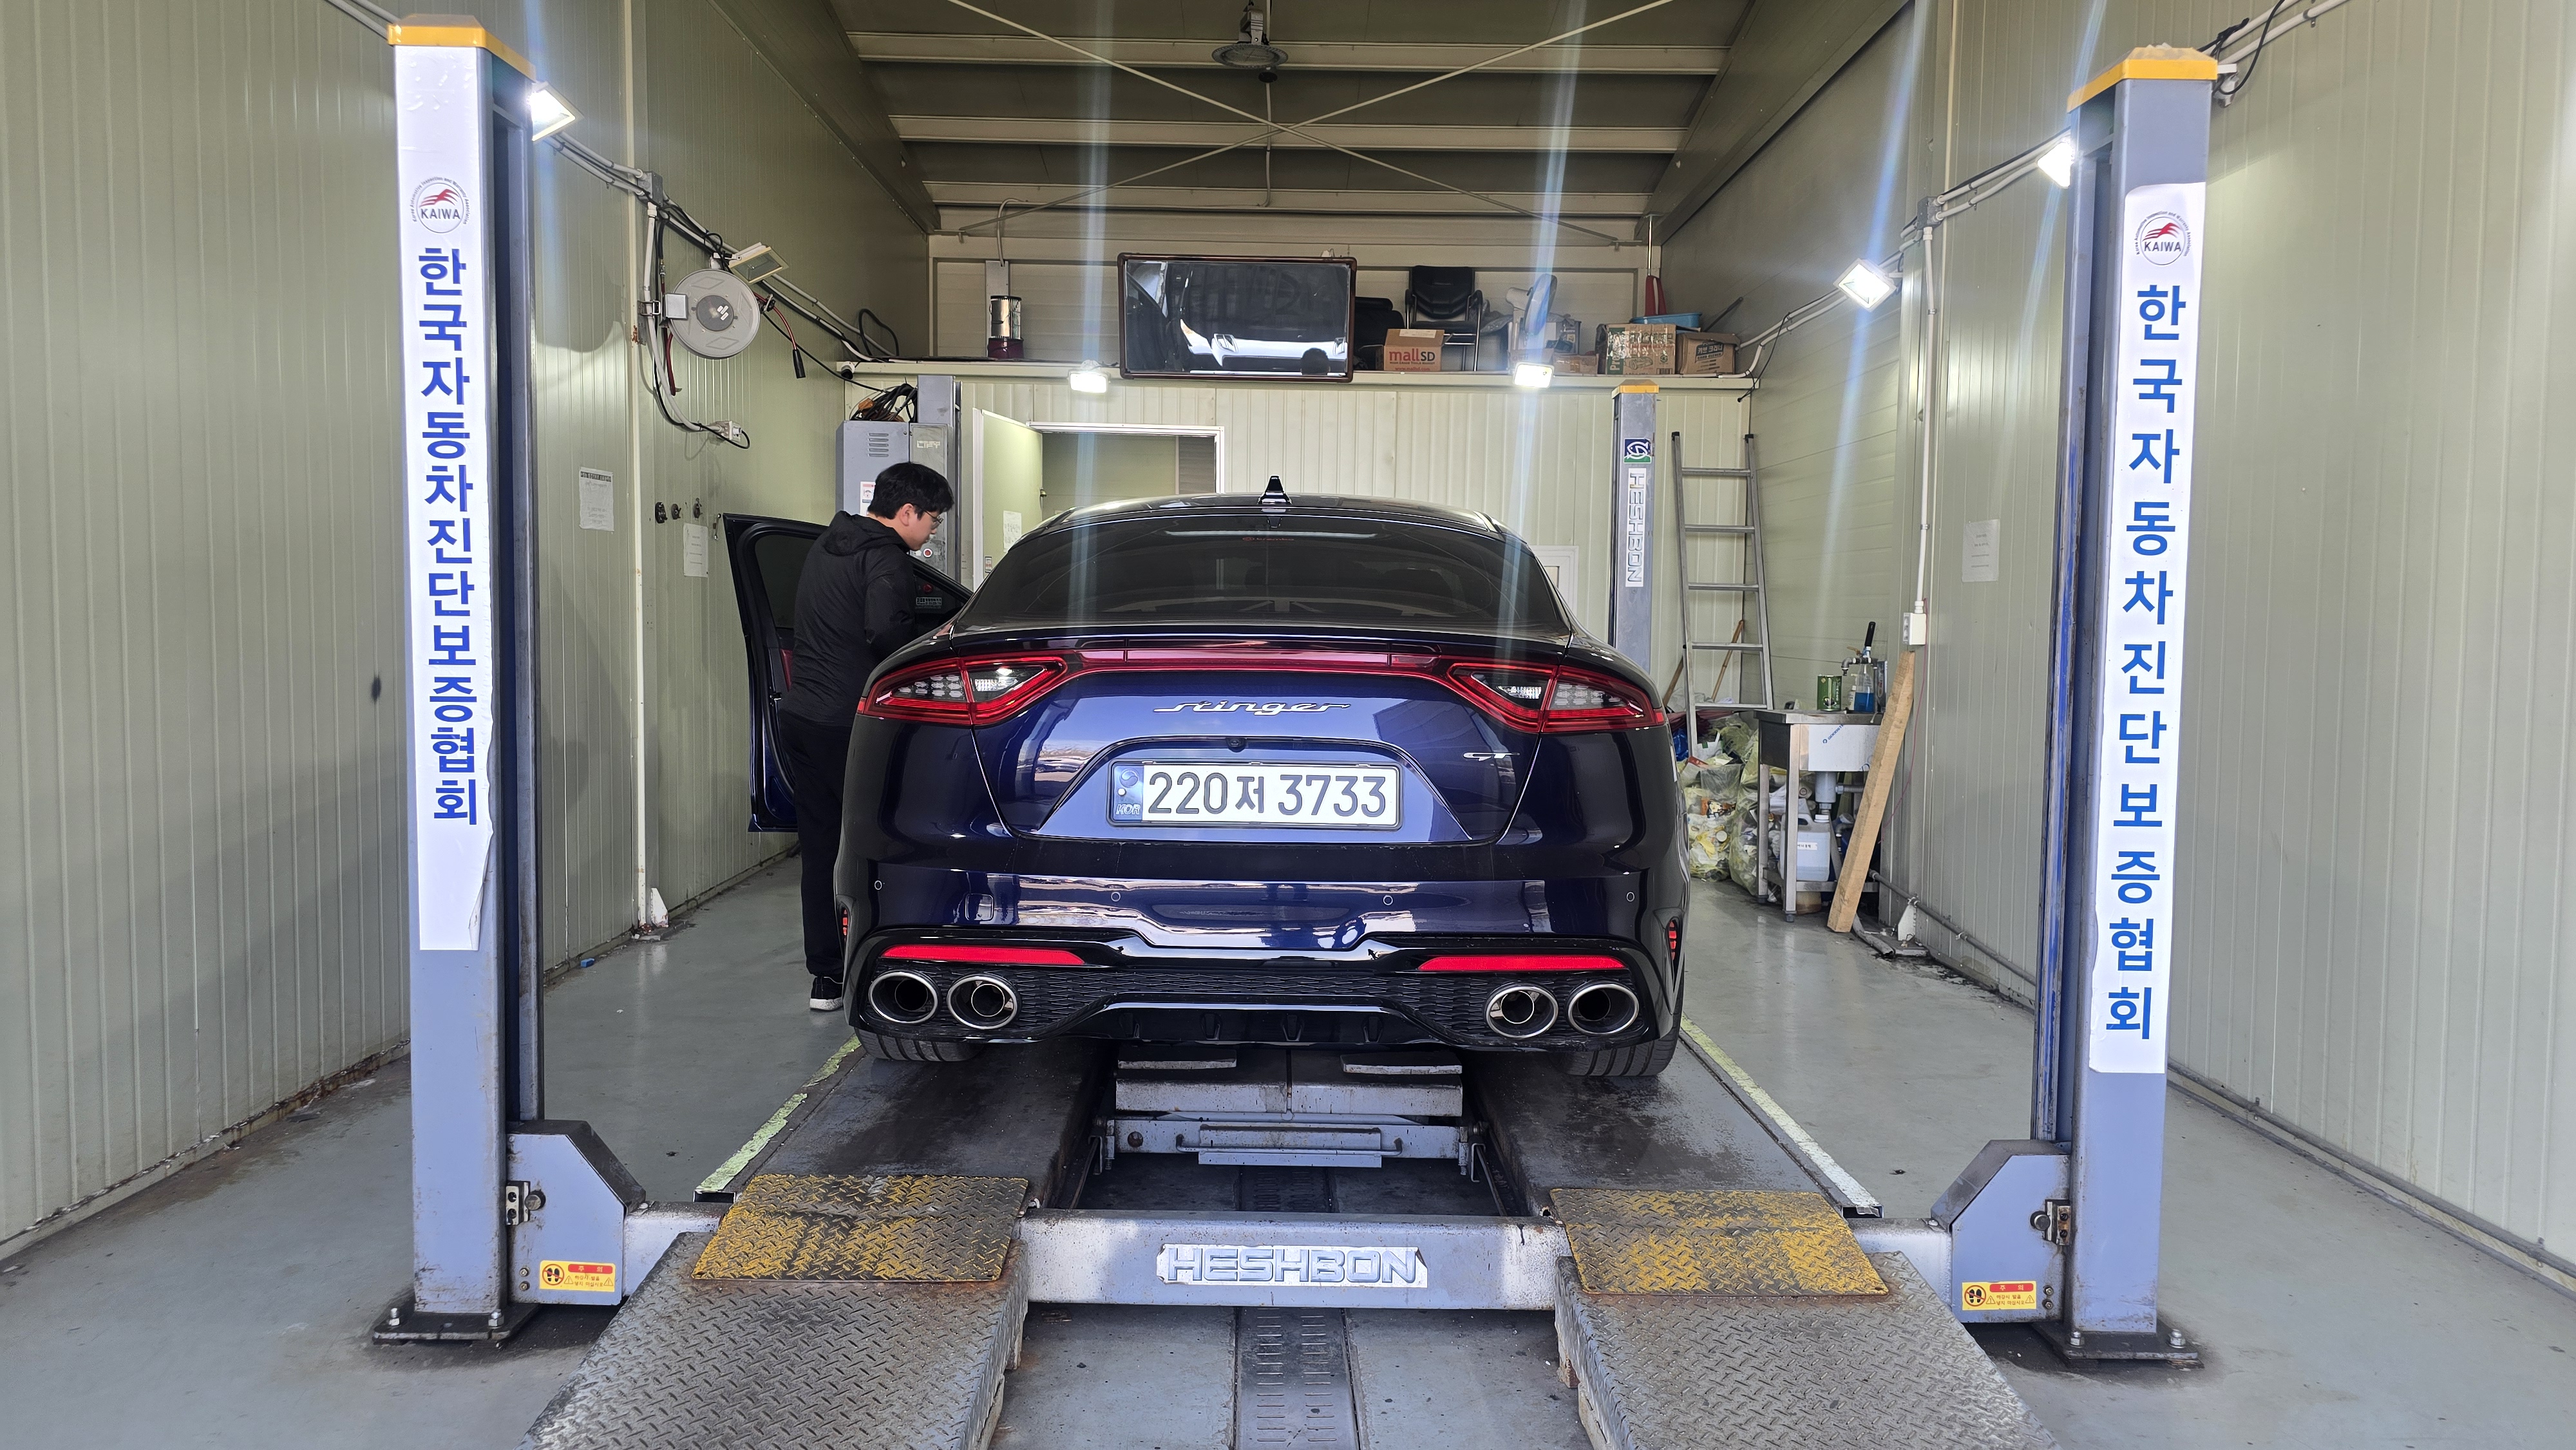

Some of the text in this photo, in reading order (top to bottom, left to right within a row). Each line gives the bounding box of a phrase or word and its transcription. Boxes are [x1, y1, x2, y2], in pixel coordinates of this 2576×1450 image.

[421, 208, 461, 220] KAIWA
[2144, 241, 2182, 252] KAIWA
[1389, 348, 1435, 362] mallSD
[418, 247, 477, 825] 한국자동차진단보증협회
[1627, 472, 1645, 583] HESHBON
[2105, 284, 2186, 1040] 한국자동차진단보증협회
[1115, 803, 1141, 815] KOR
[1148, 771, 1386, 818] 220저 3733
[1168, 1247, 1418, 1284] HESHBON
